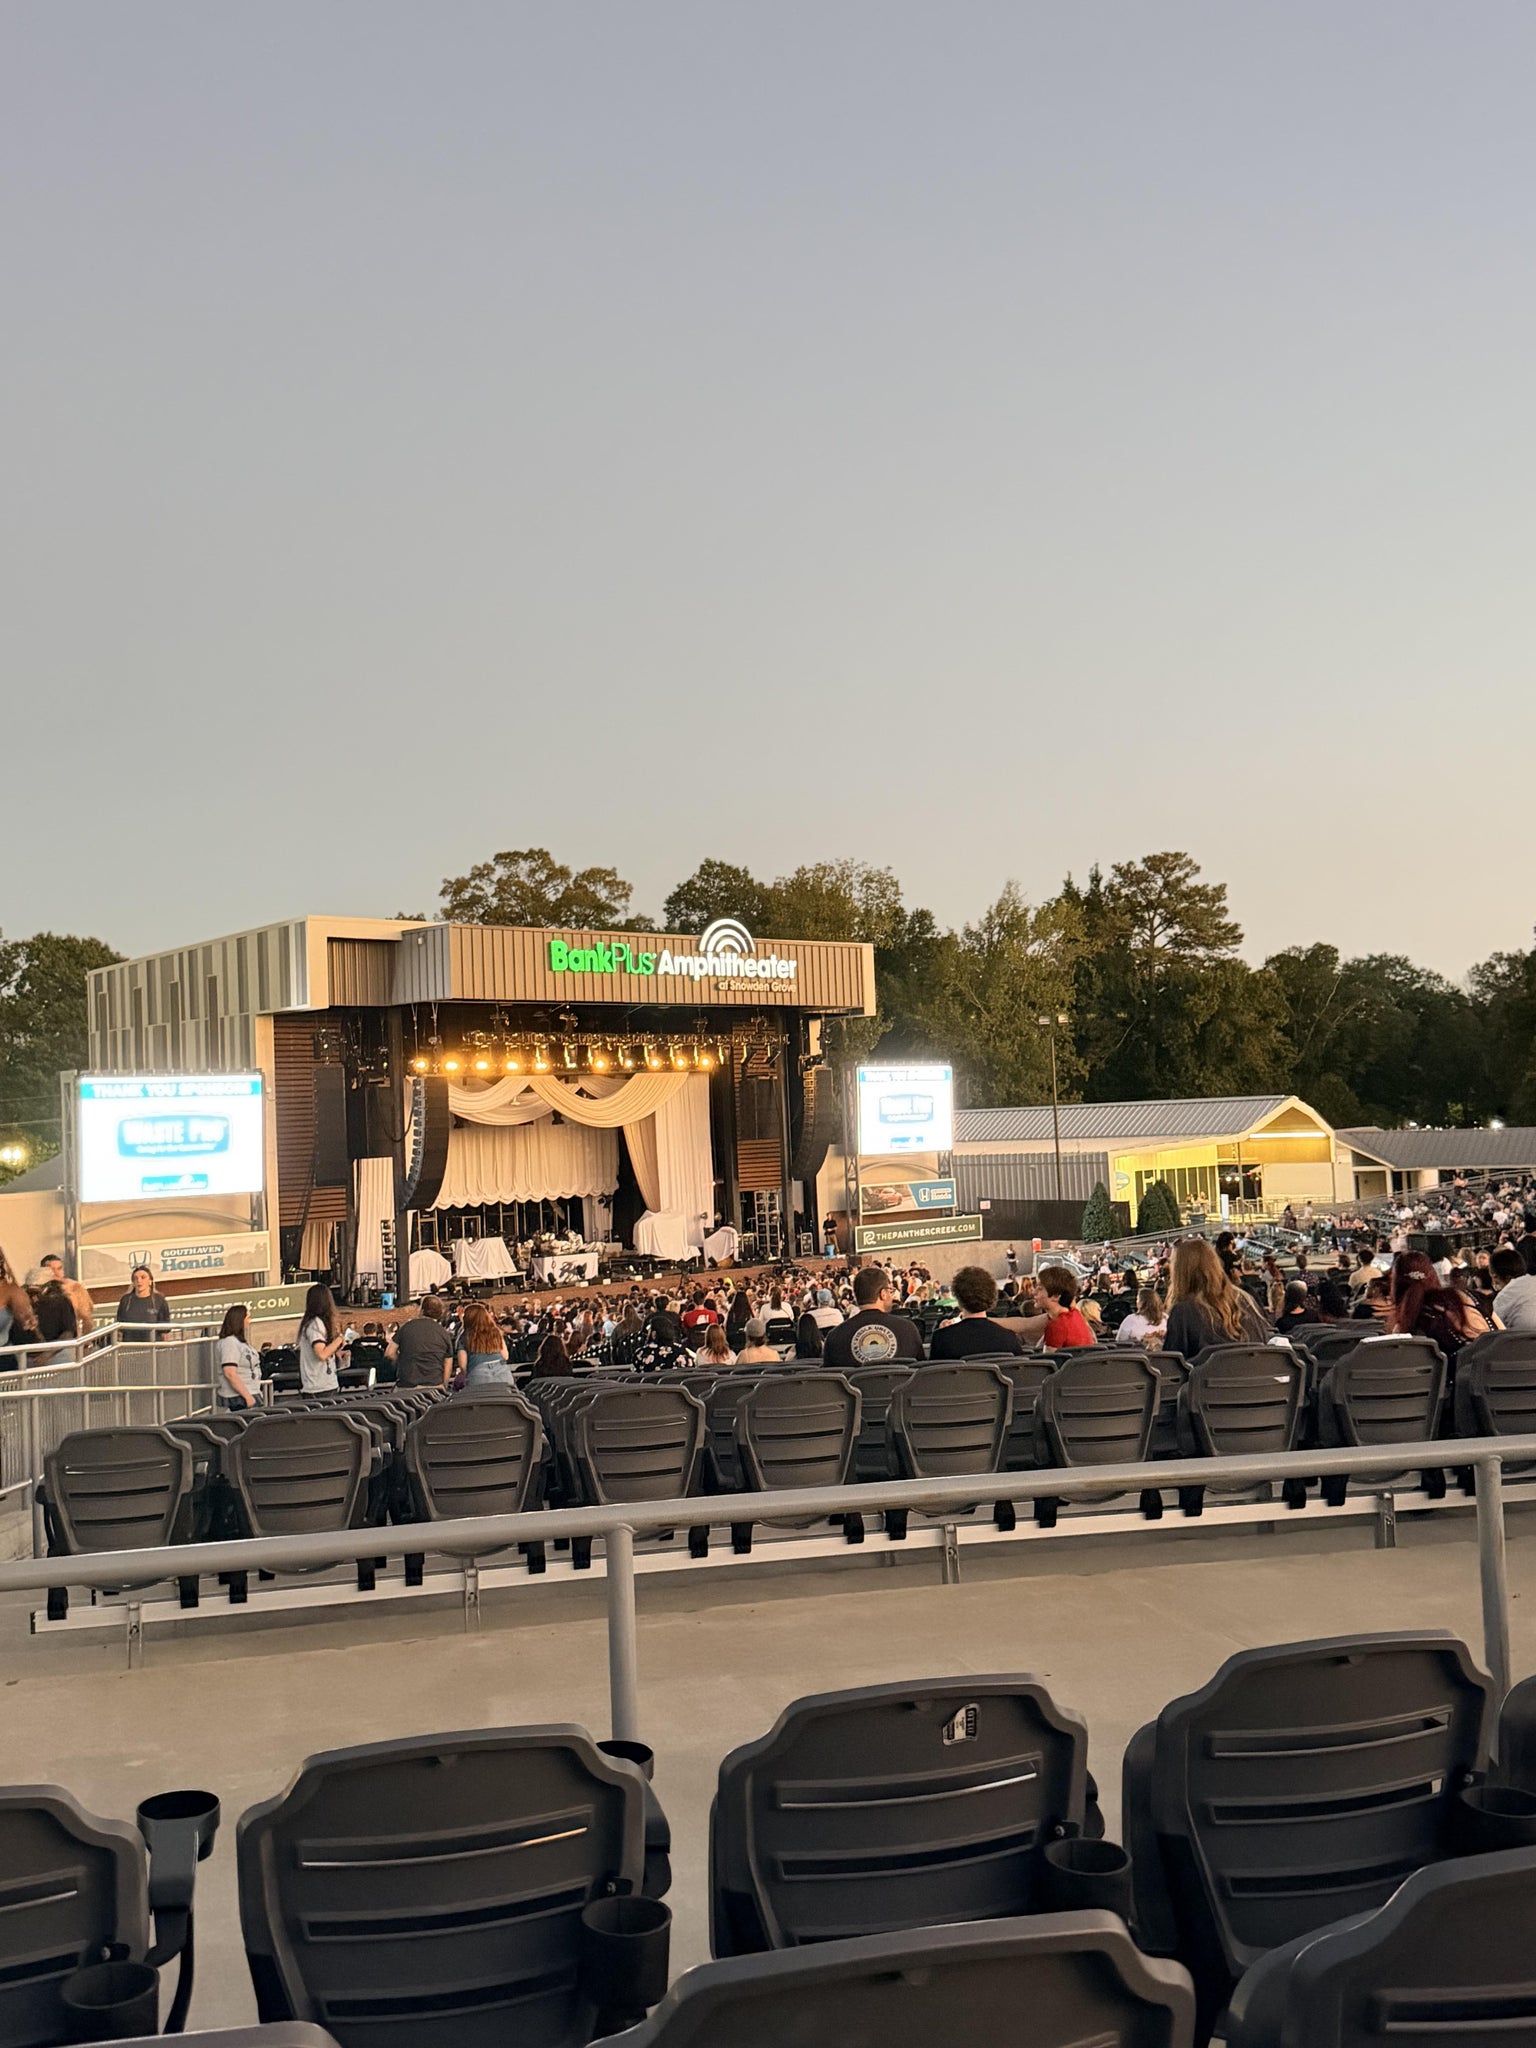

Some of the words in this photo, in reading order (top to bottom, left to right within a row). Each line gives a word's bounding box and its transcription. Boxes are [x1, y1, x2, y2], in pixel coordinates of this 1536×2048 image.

[658, 949, 797, 981] Amphitheater
[730, 980, 769, 992] Snowden
[771, 981, 797, 992] Grove
[876, 1224, 975, 1240] THEPANTHERCREEK.COM
[163, 1245, 222, 1257] SOUTHAVEN
[161, 1256, 224, 1272] Honda
